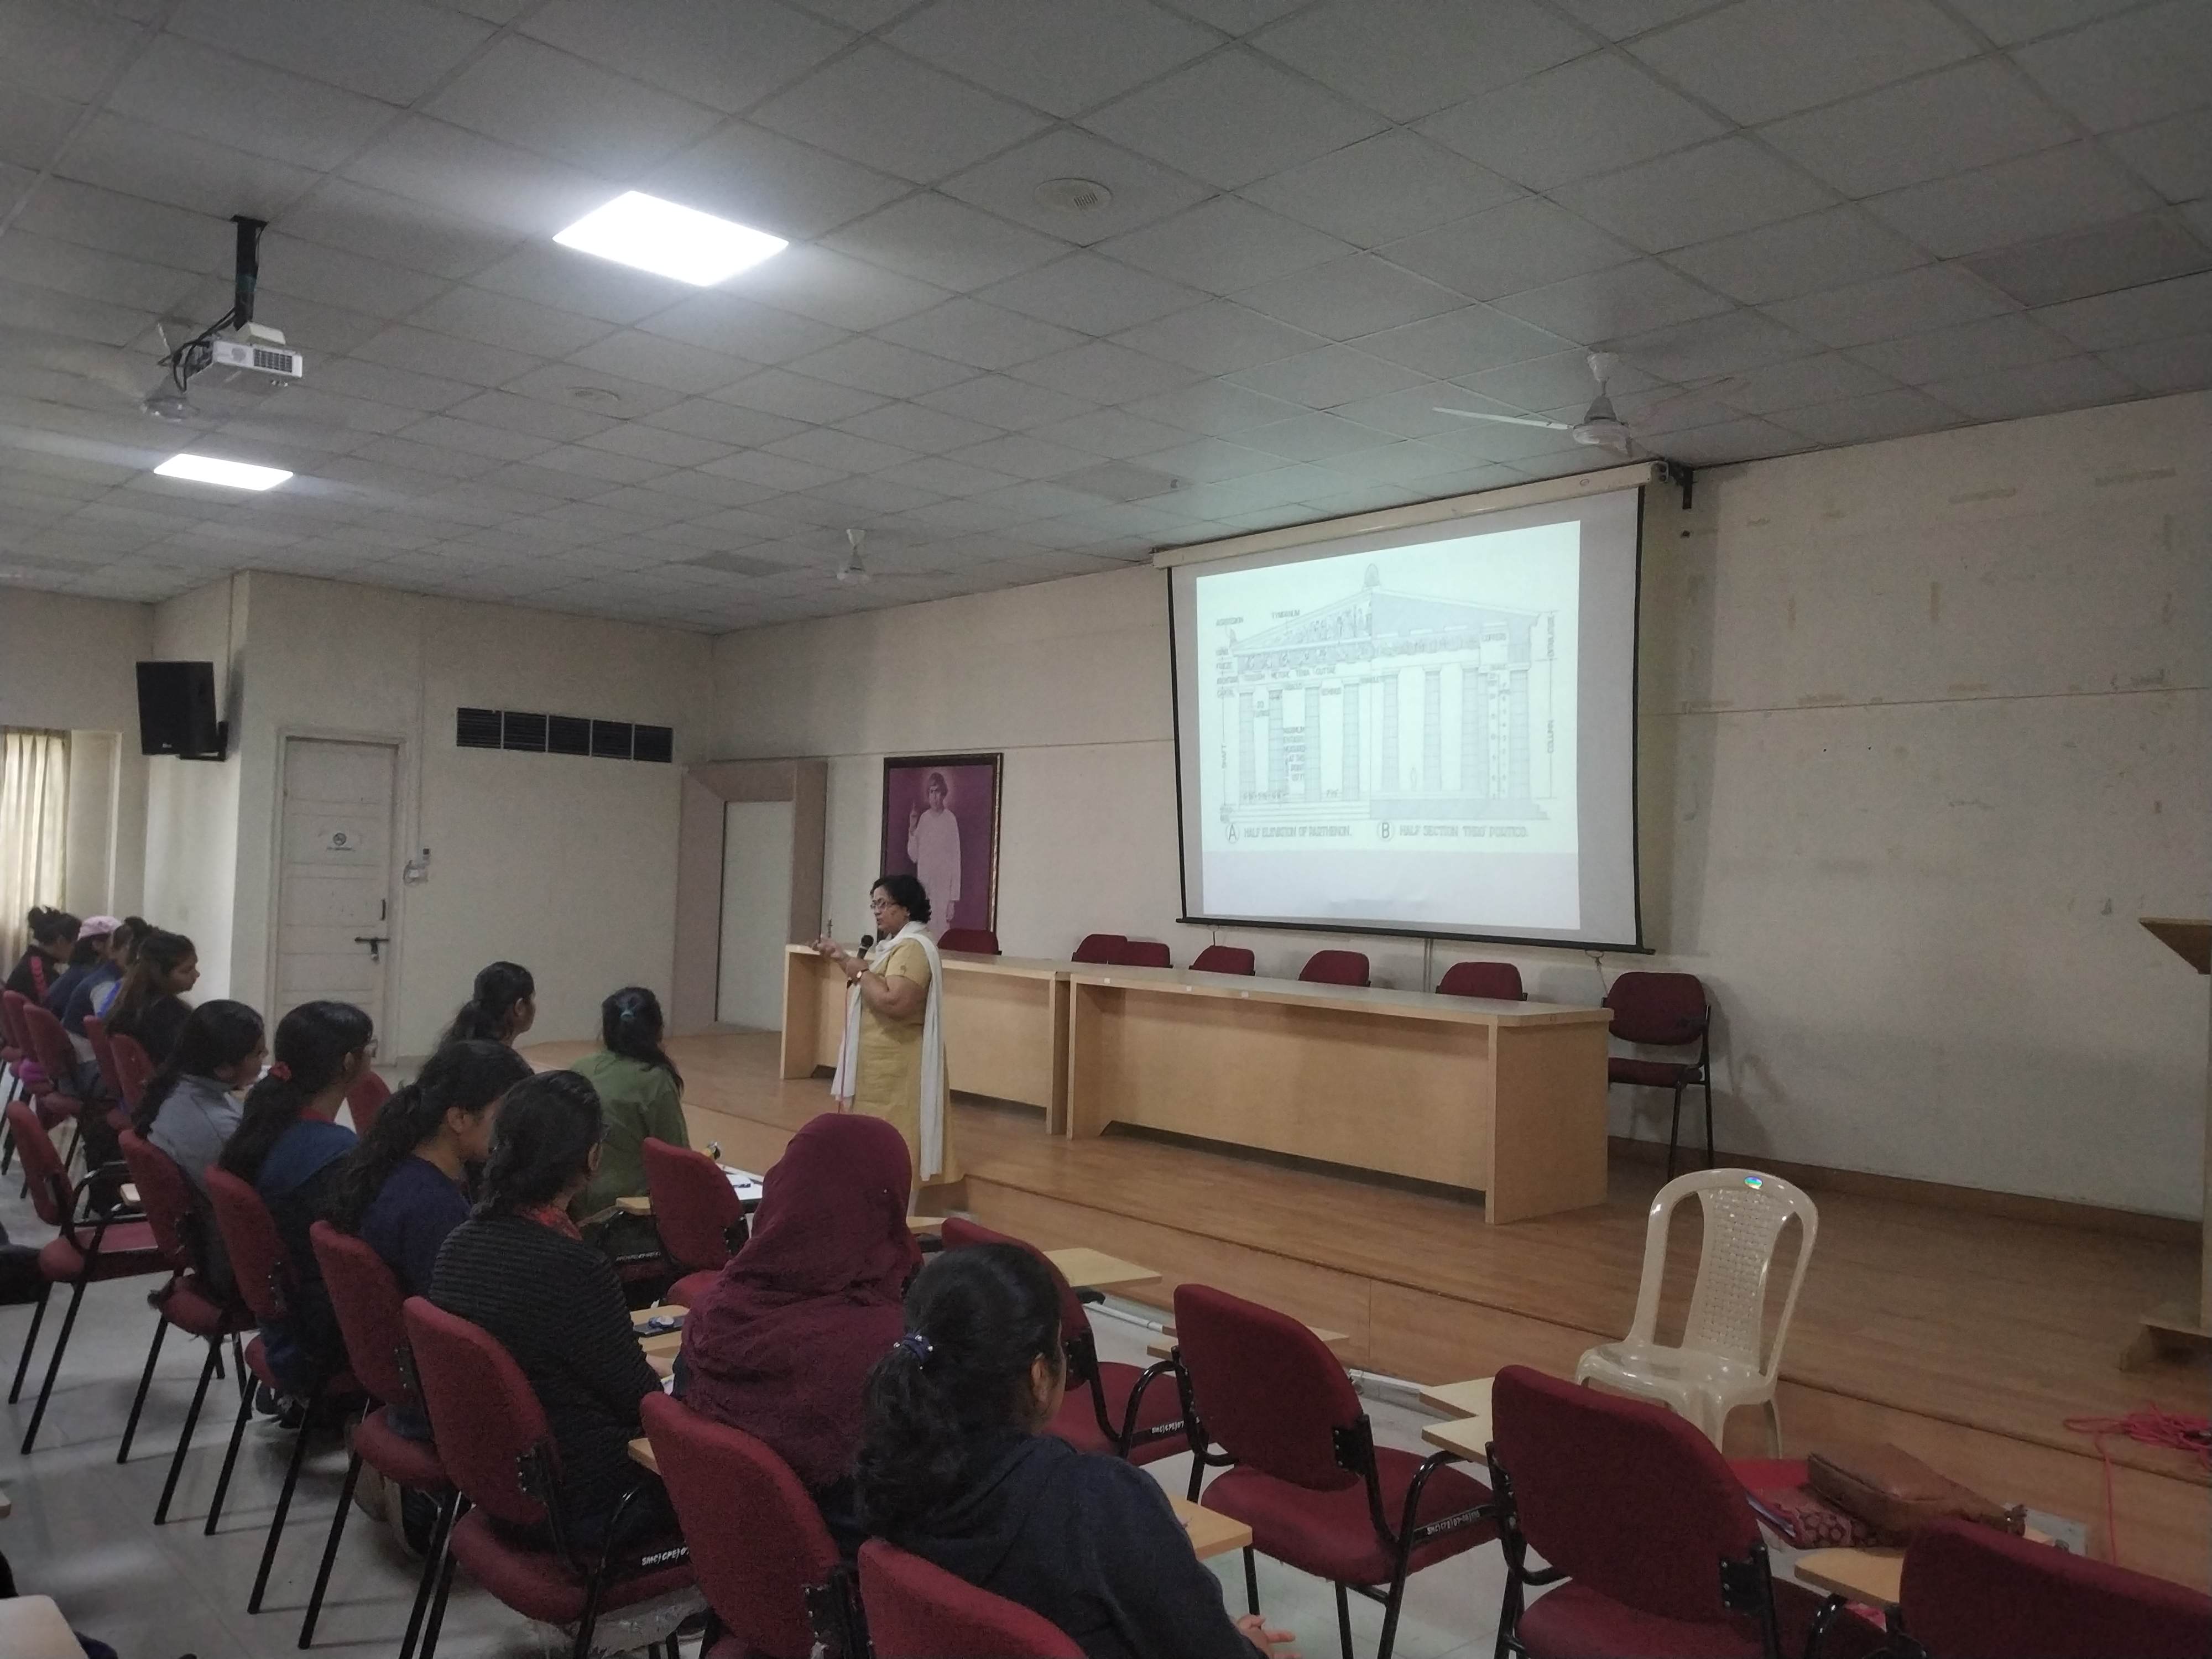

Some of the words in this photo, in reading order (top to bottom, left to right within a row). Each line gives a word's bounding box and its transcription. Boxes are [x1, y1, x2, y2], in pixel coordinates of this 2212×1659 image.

[1228, 823, 1237, 841] A
[1244, 827, 1261, 838] HALF
[1262, 826, 1297, 837] ELEVATION
[1298, 826, 1307, 837] OF
[1381, 822, 1390, 839] B
[1400, 825, 1421, 836] HALF
[1423, 825, 1459, 837] SECTION
